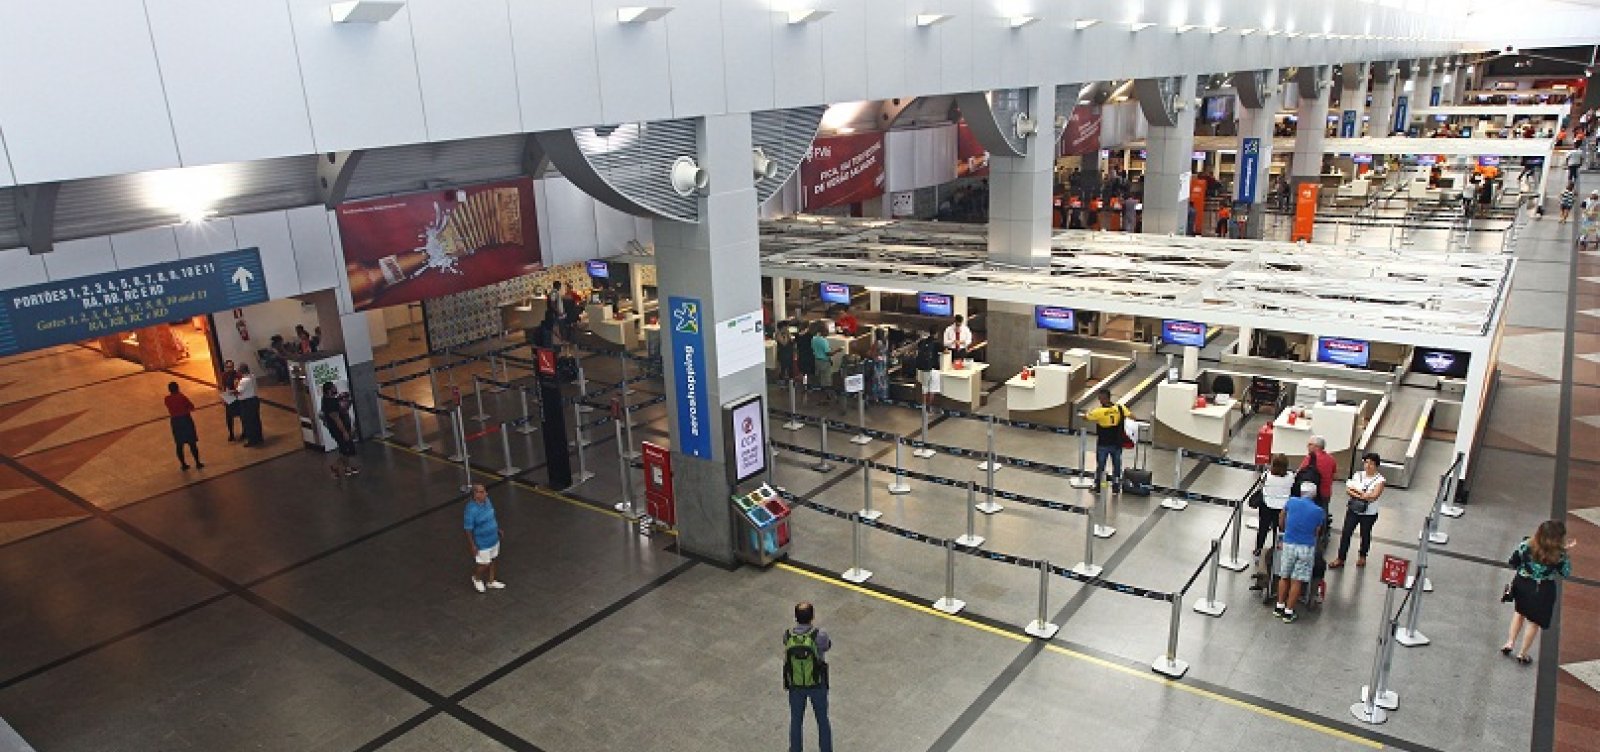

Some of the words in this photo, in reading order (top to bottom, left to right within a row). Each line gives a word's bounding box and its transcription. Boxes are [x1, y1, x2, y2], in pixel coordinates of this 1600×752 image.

[13, 288, 68, 310] PORTÕES
[195, 264, 202, 276] E
[36, 318, 67, 332] Gates
[684, 345, 699, 437] aeroshopping
